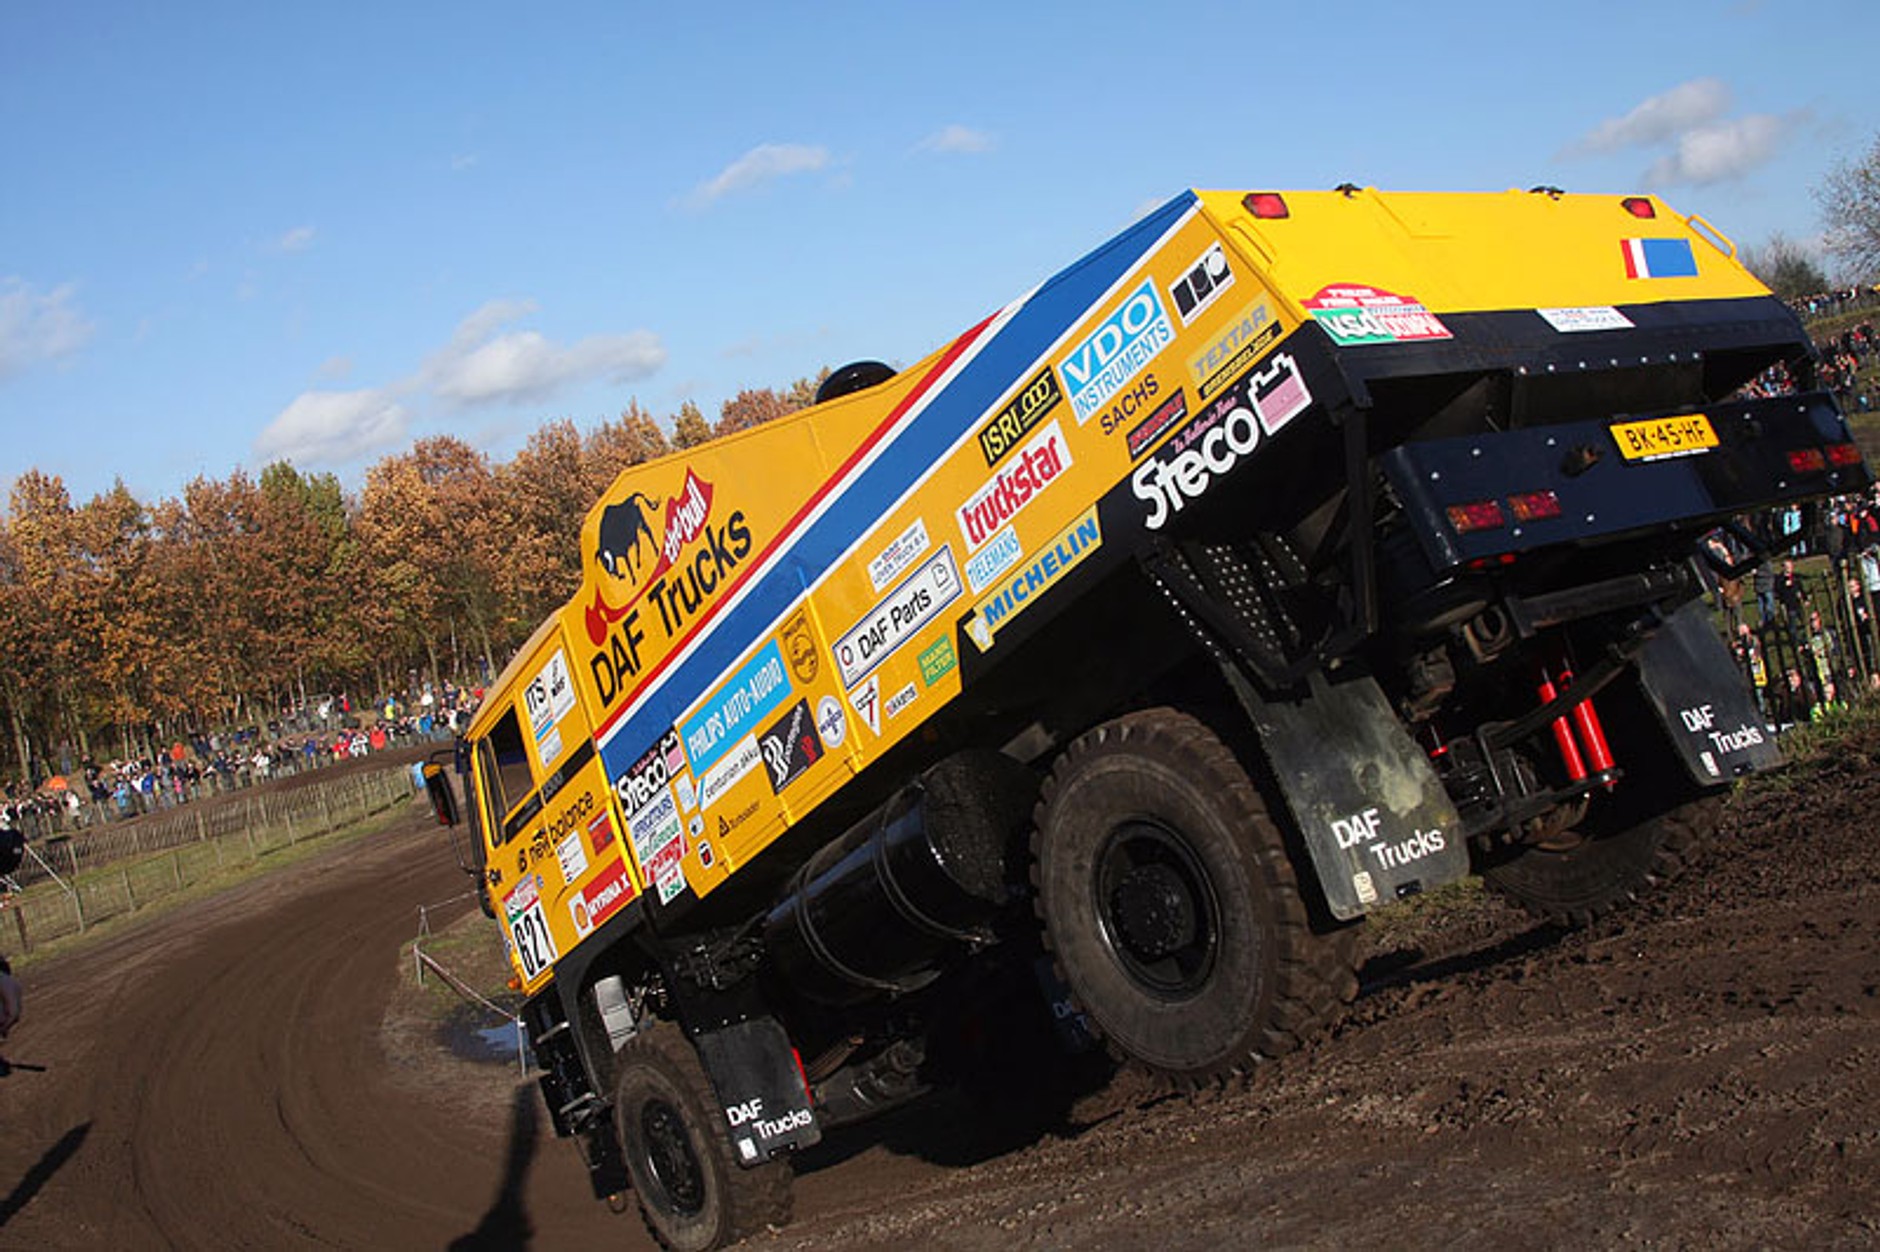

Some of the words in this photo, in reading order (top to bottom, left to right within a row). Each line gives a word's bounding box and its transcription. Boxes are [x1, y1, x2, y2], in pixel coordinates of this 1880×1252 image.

[1064, 293, 1155, 384] VDO
[1074, 319, 1170, 416] INSTRUMENTS
[1195, 304, 1267, 377] TEXTAR
[981, 404, 1023, 462] ISRI
[1100, 373, 1160, 436] SACHS
[962, 436, 1062, 544] truckstar
[1133, 407, 1260, 530] Steco
[678, 475, 708, 542] bull
[983, 518, 1099, 627] MICHELIN
[590, 609, 645, 709] DAF
[647, 510, 752, 639] Trucks
[858, 617, 889, 660] DAF
[890, 588, 932, 632] Parts
[688, 711, 726, 763] PHILIPS
[723, 657, 783, 730] AUTO-AUDIO
[1680, 704, 1715, 732] DAF
[1708, 723, 1764, 754] Trucks
[618, 757, 667, 817] Steco
[529, 838, 555, 866] new
[550, 790, 594, 844] balance
[1331, 807, 1382, 850] DAF
[1370, 828, 1445, 870] Trucks
[620, 871, 631, 890] X
[726, 1098, 763, 1127] DAF
[752, 1109, 812, 1139] Trucks
